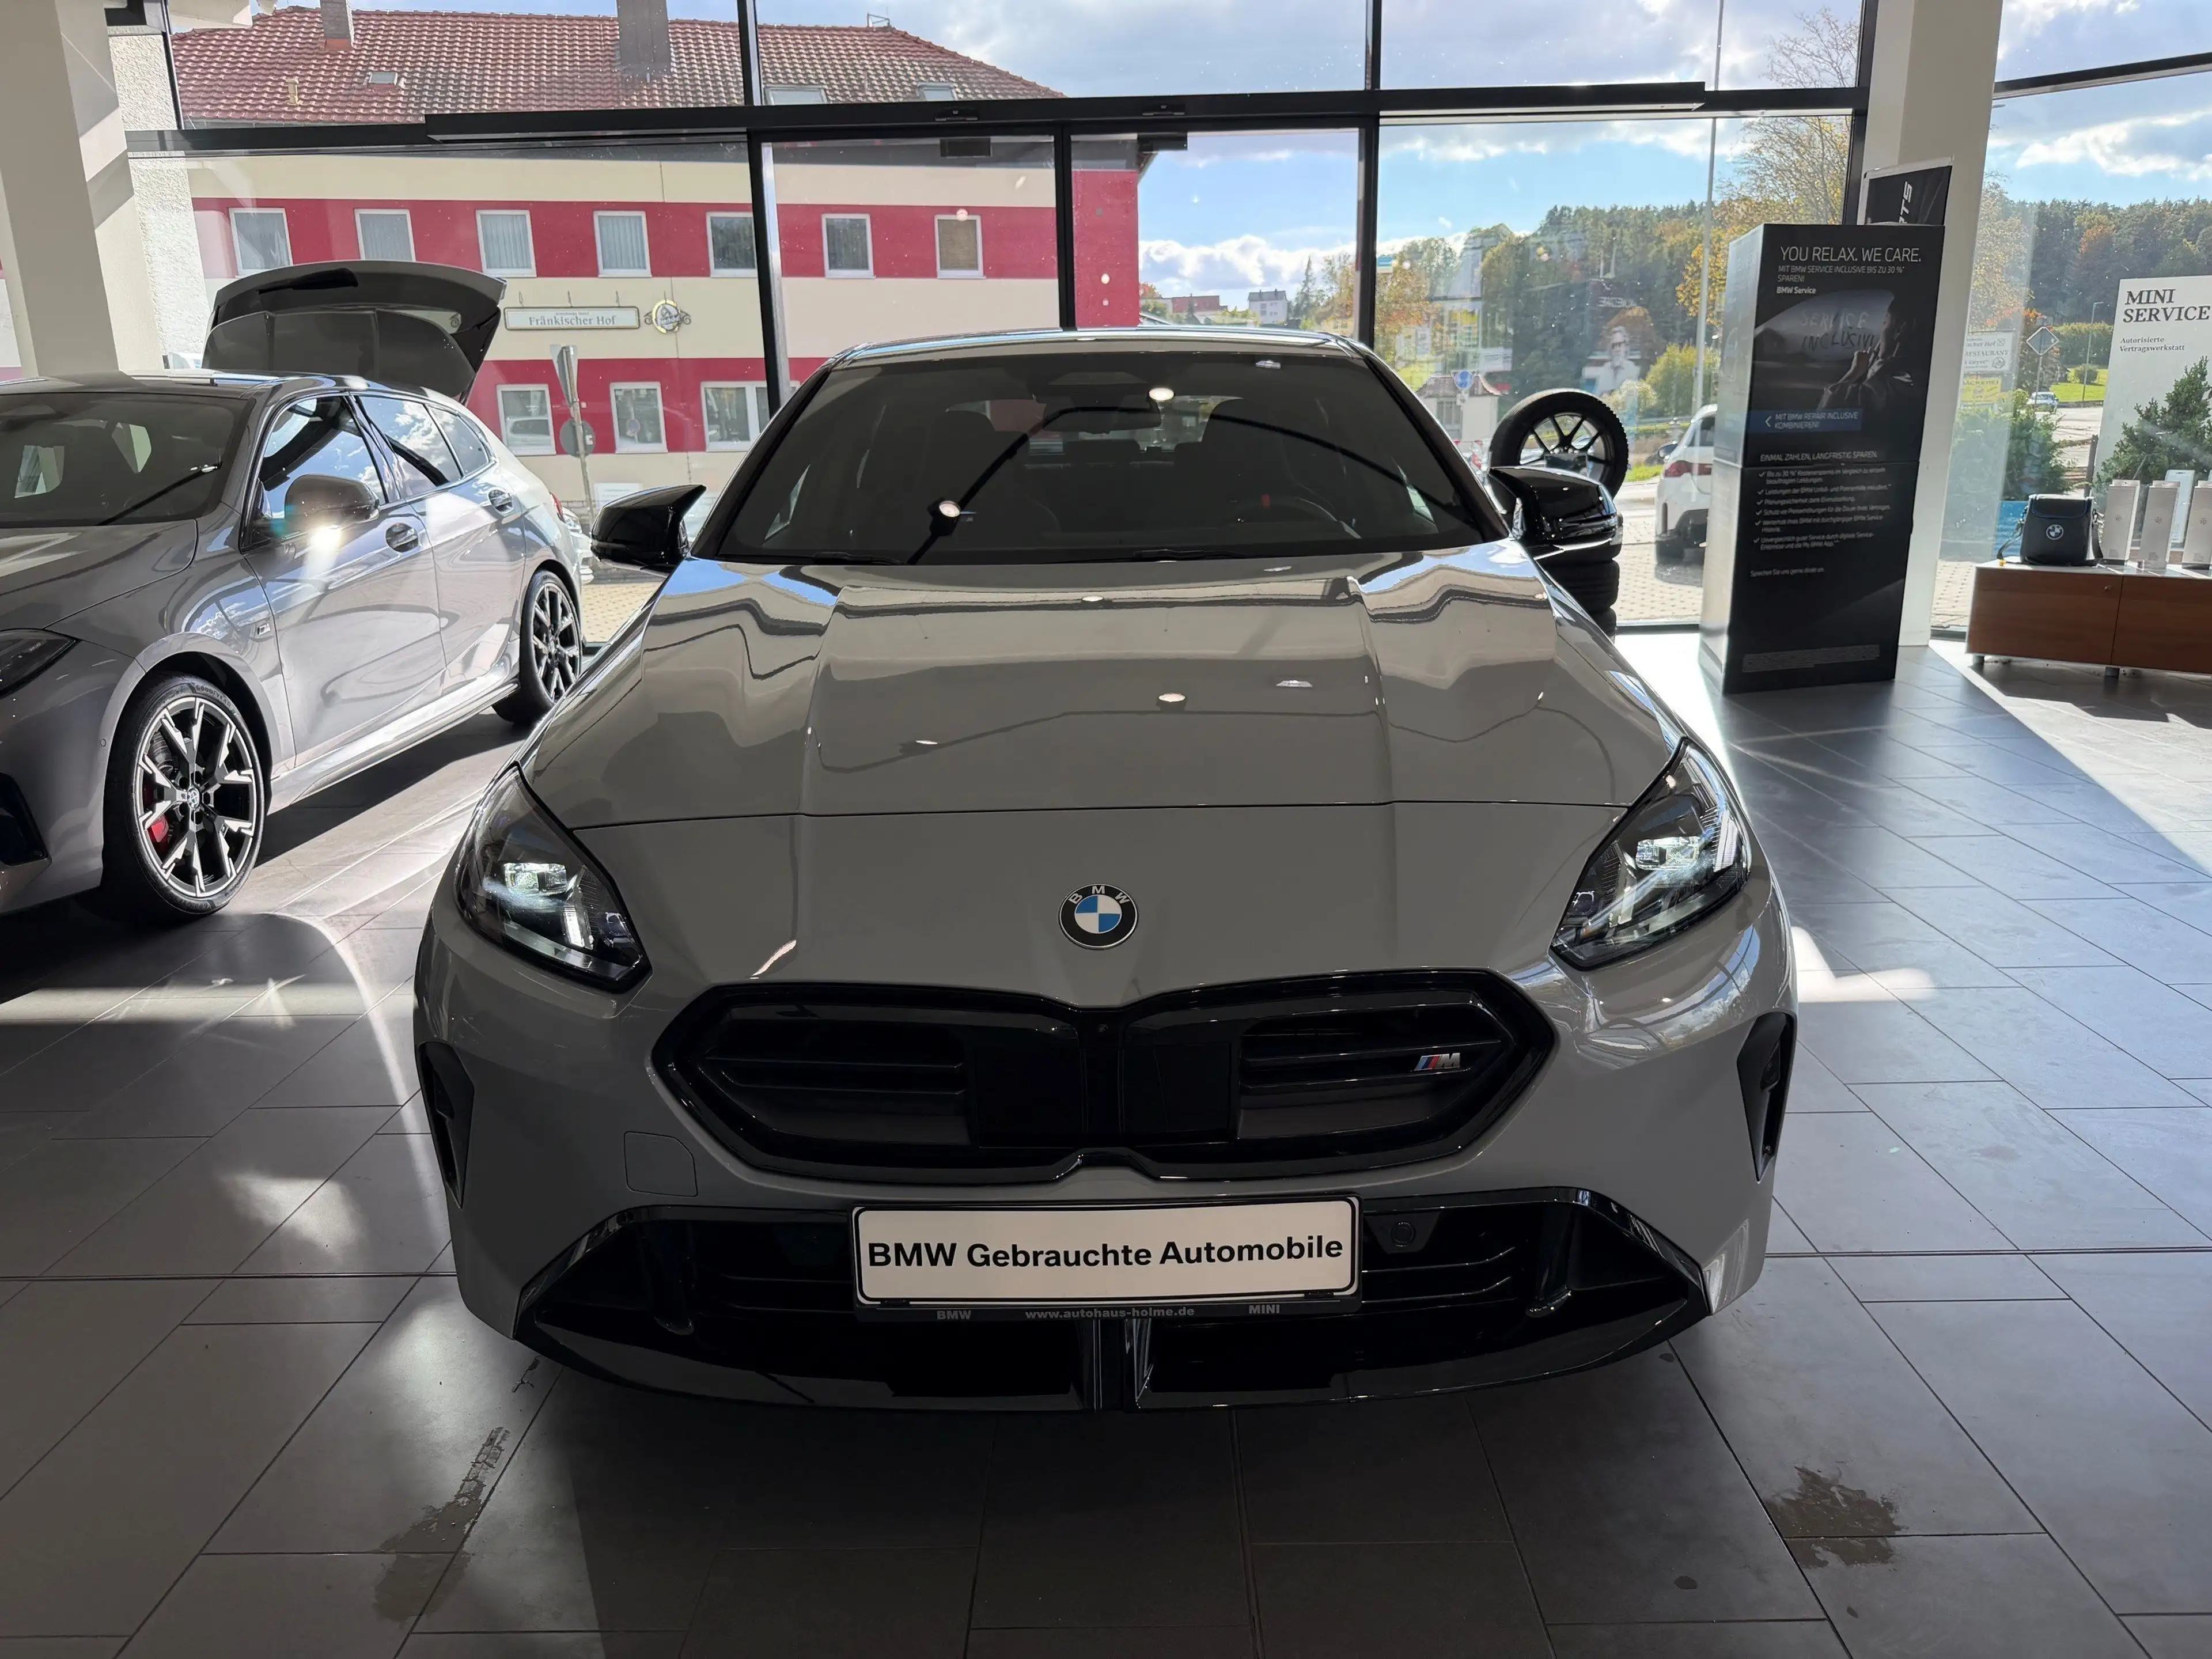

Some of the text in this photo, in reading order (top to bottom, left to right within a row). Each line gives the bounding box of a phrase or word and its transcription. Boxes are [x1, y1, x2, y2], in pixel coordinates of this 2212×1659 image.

[1780, 247, 1921, 262] YOU RELAX. WE CARE.
[2124, 289, 2176, 305] MINI
[529, 316, 616, 326] Fränkischer Hof
[2123, 305, 2210, 323] SERVICE
[2120, 344, 2184, 353] Vertragswerkstatt
[1068, 885, 1130, 904] BMW
[868, 1235, 1343, 1267] BMW Gebrauchte Automobile
[937, 1304, 1281, 1320] BMW www.autohaus-holme.de MINI
